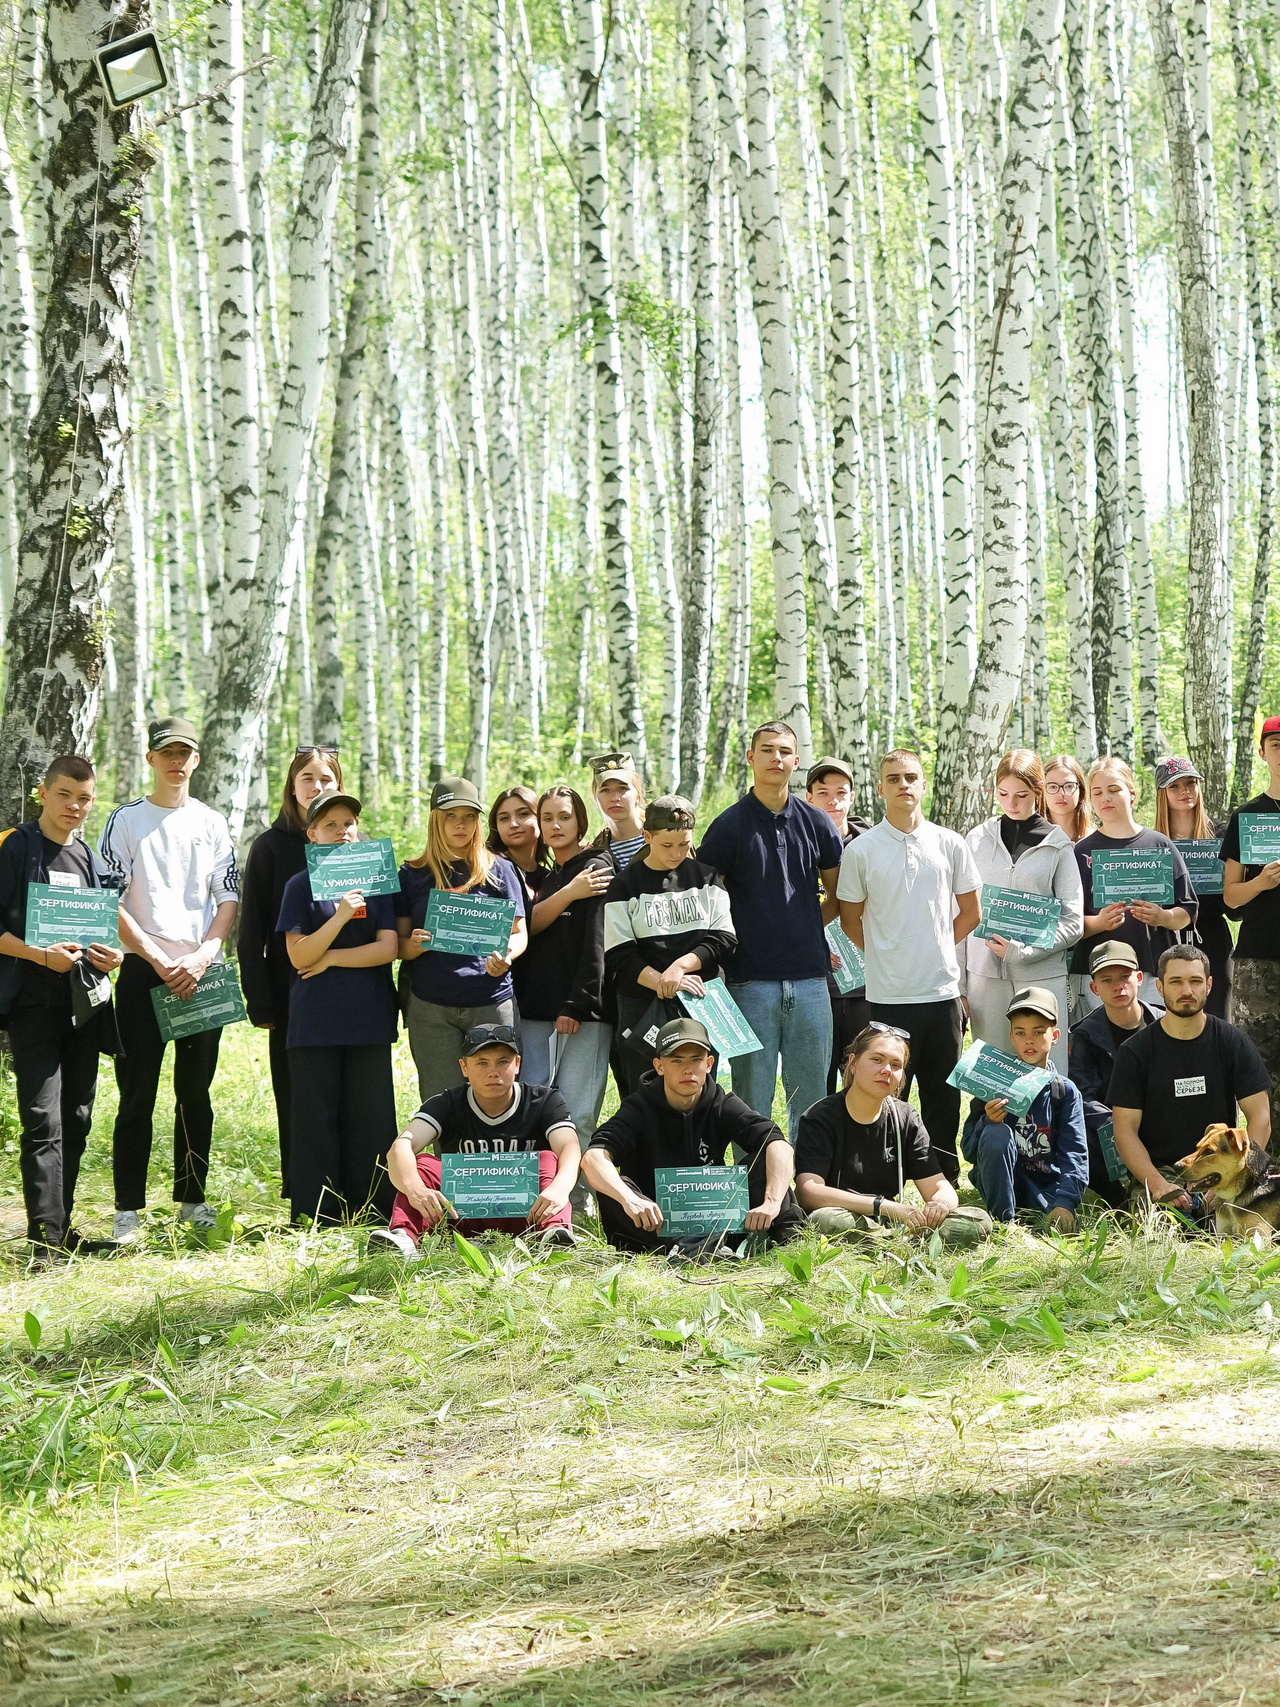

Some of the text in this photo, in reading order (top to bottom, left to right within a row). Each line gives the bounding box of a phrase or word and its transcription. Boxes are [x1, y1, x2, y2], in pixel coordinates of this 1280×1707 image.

[1180, 851, 1220, 859] ТИФИКАТ
[1103, 861, 1162, 871] СЕРТИФИКАТ
[323, 874, 387, 888] СЕРТИФИКАТ
[39, 897, 107, 911] СЕРТИФИКАТ
[986, 897, 1050, 916] СЕРТИФИКАТ
[439, 904, 504, 920] СЕРТИФИКАТ
[164, 978, 226, 1004] СЕФИКАТ
[454, 1166, 527, 1177] СЕРТИФИКАТ
[669, 1181, 736, 1193] СЕРТИФИКАТ
